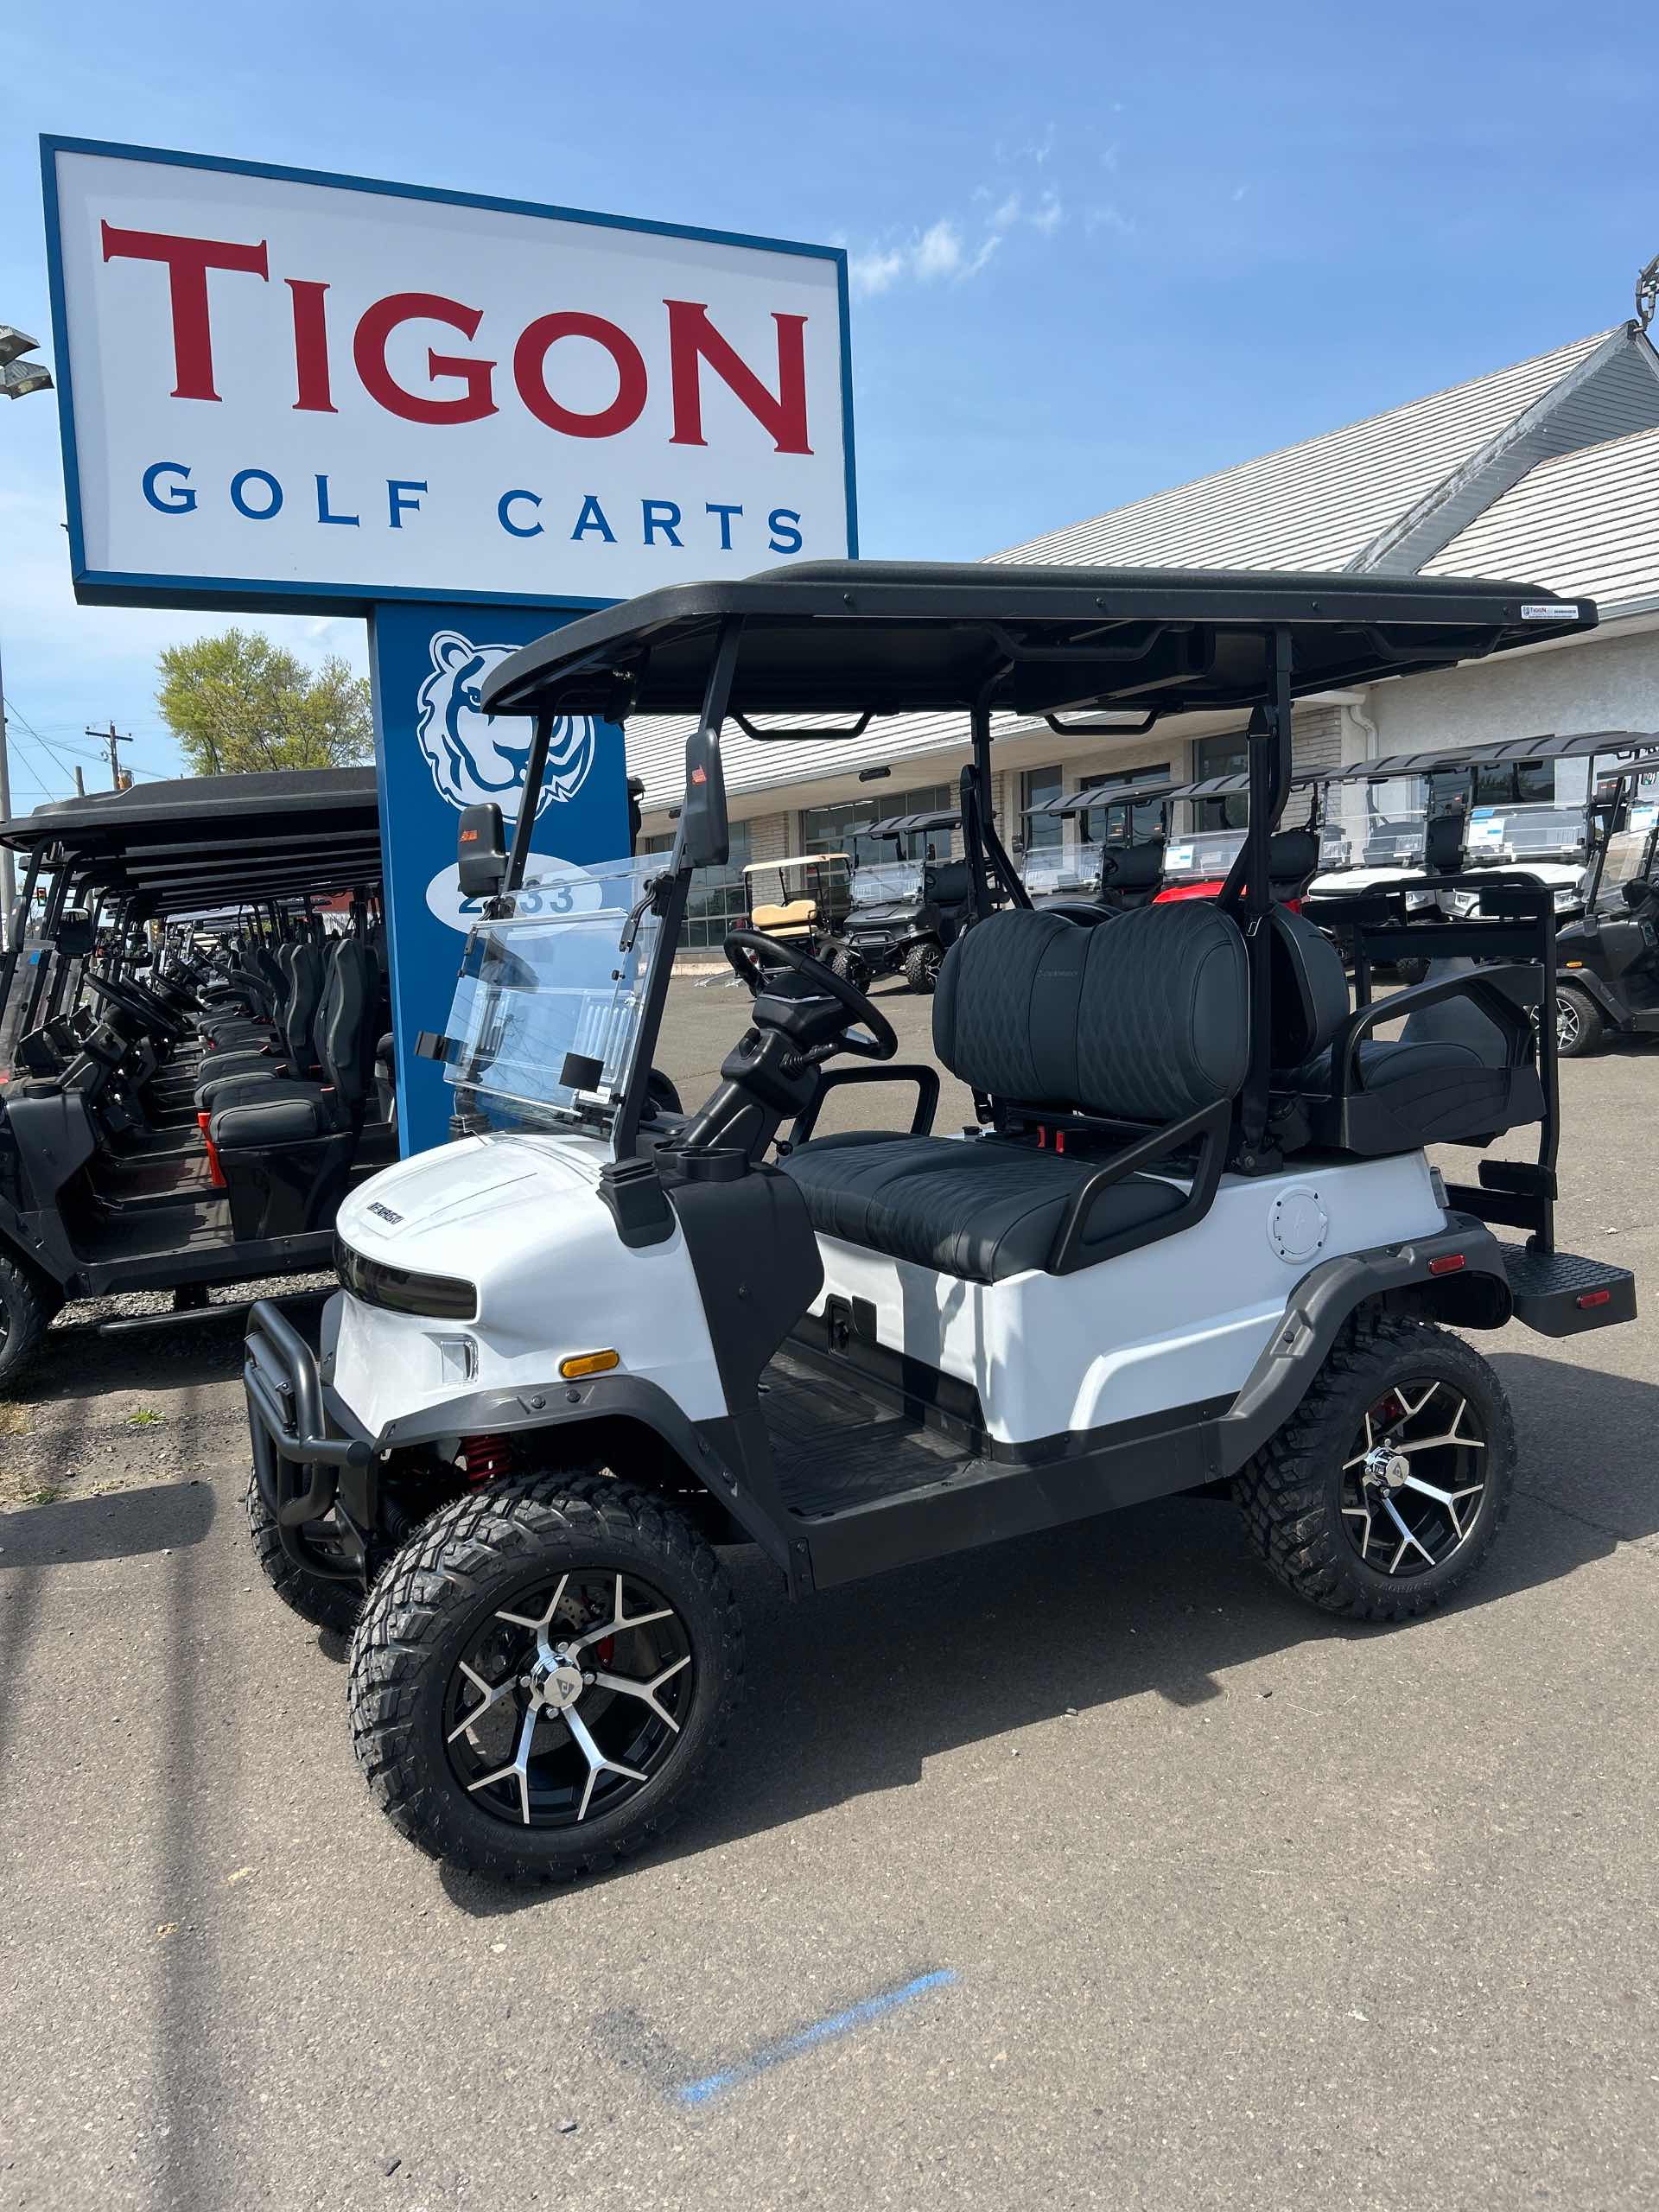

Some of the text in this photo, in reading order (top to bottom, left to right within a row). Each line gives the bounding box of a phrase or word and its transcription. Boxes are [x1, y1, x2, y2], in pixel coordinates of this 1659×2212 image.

[101, 219, 814, 455] TIGON
[143, 461, 804, 555] GOLF CARTS
